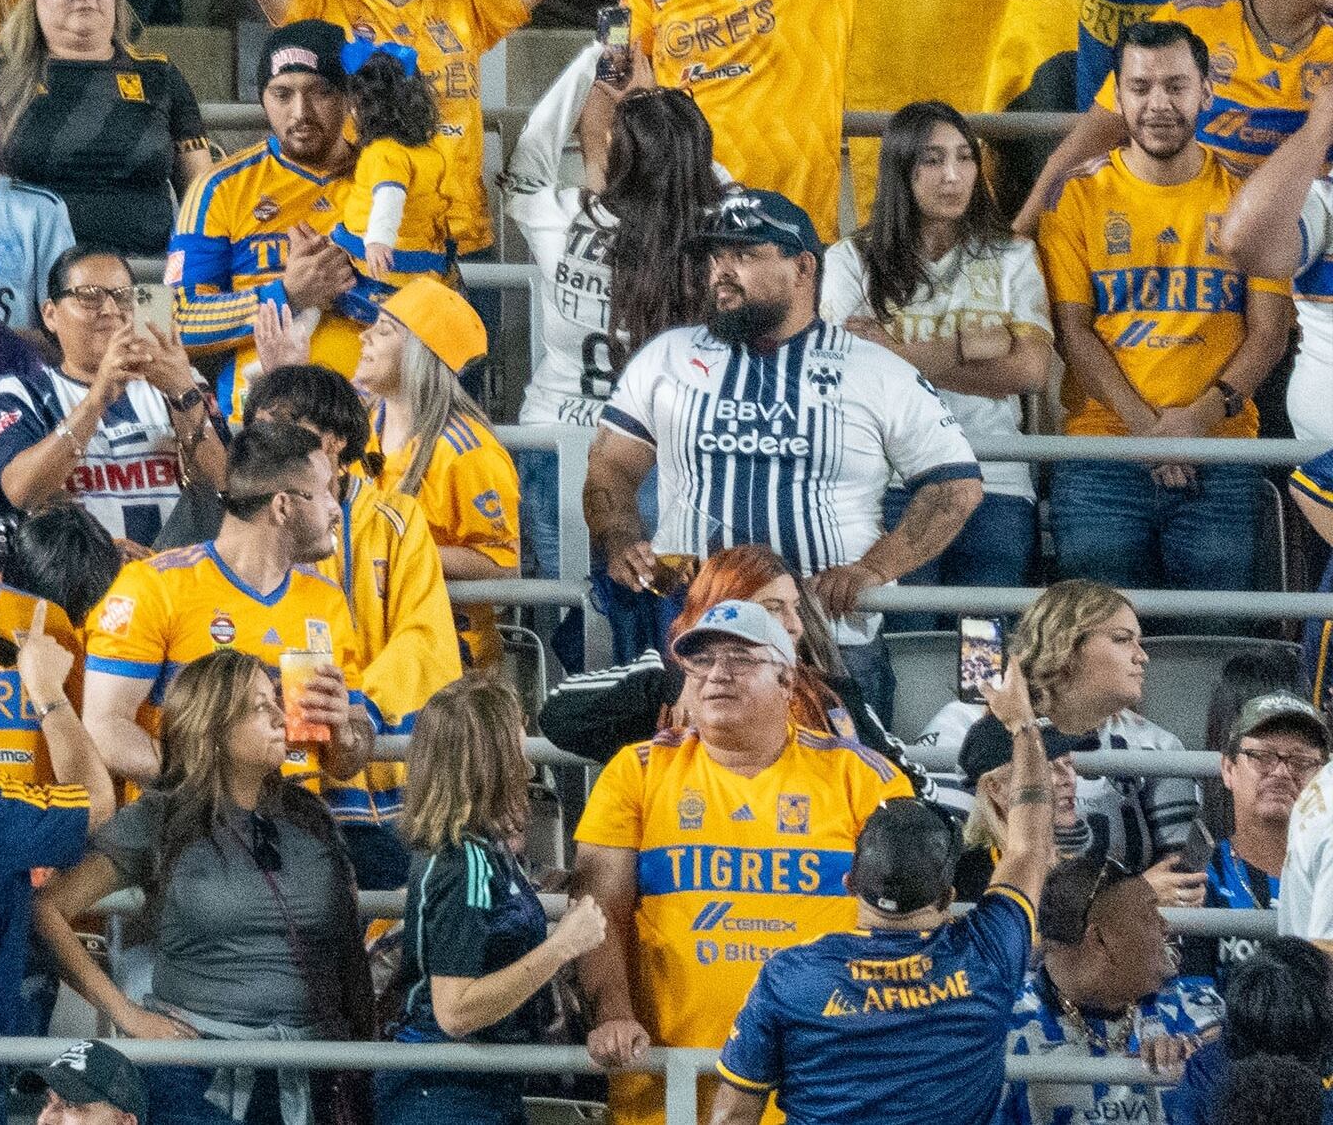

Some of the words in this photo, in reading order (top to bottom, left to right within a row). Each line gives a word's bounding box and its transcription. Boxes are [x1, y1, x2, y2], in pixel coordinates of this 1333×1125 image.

[1095, 271, 1240, 313] TIGRES
[716, 399, 797, 421] BBVA
[698, 430, 810, 457] codere
[668, 848, 821, 891] TIGRES
[864, 970, 971, 1014] AFIRME
